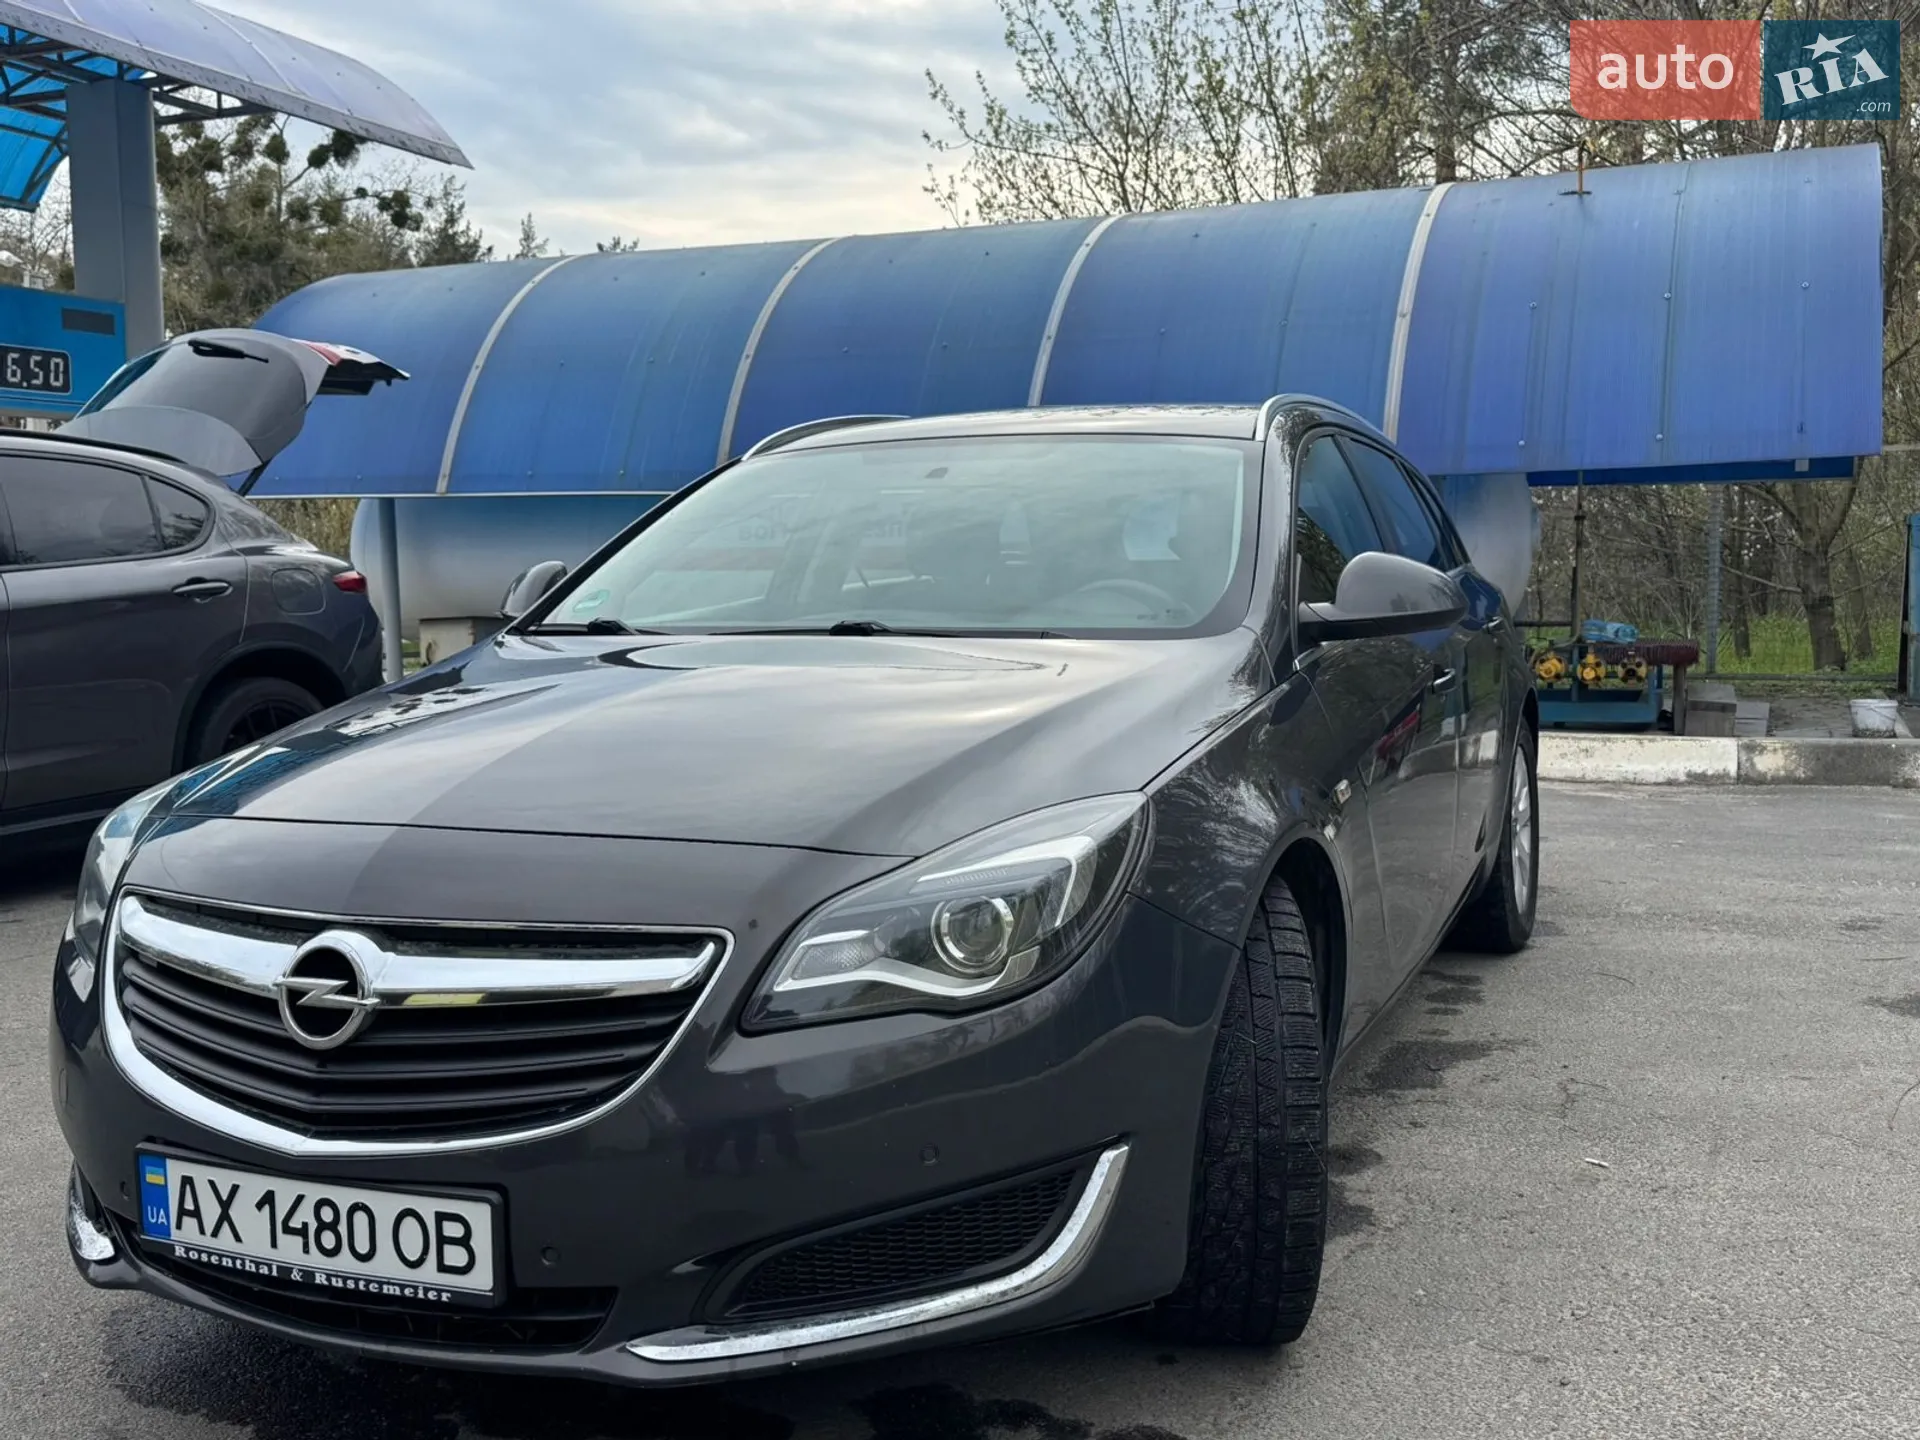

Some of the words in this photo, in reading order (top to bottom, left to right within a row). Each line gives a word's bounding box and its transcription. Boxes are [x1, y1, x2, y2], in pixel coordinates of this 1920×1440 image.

[147, 1206, 168, 1227] UA
[175, 1175, 243, 1243] AX
[254, 1189, 377, 1263] 1480
[392, 1207, 476, 1276] OB
[174, 1245, 279, 1277] Rosenthal
[290, 1267, 303, 1281] &
[314, 1272, 452, 1303] Rustemeier
